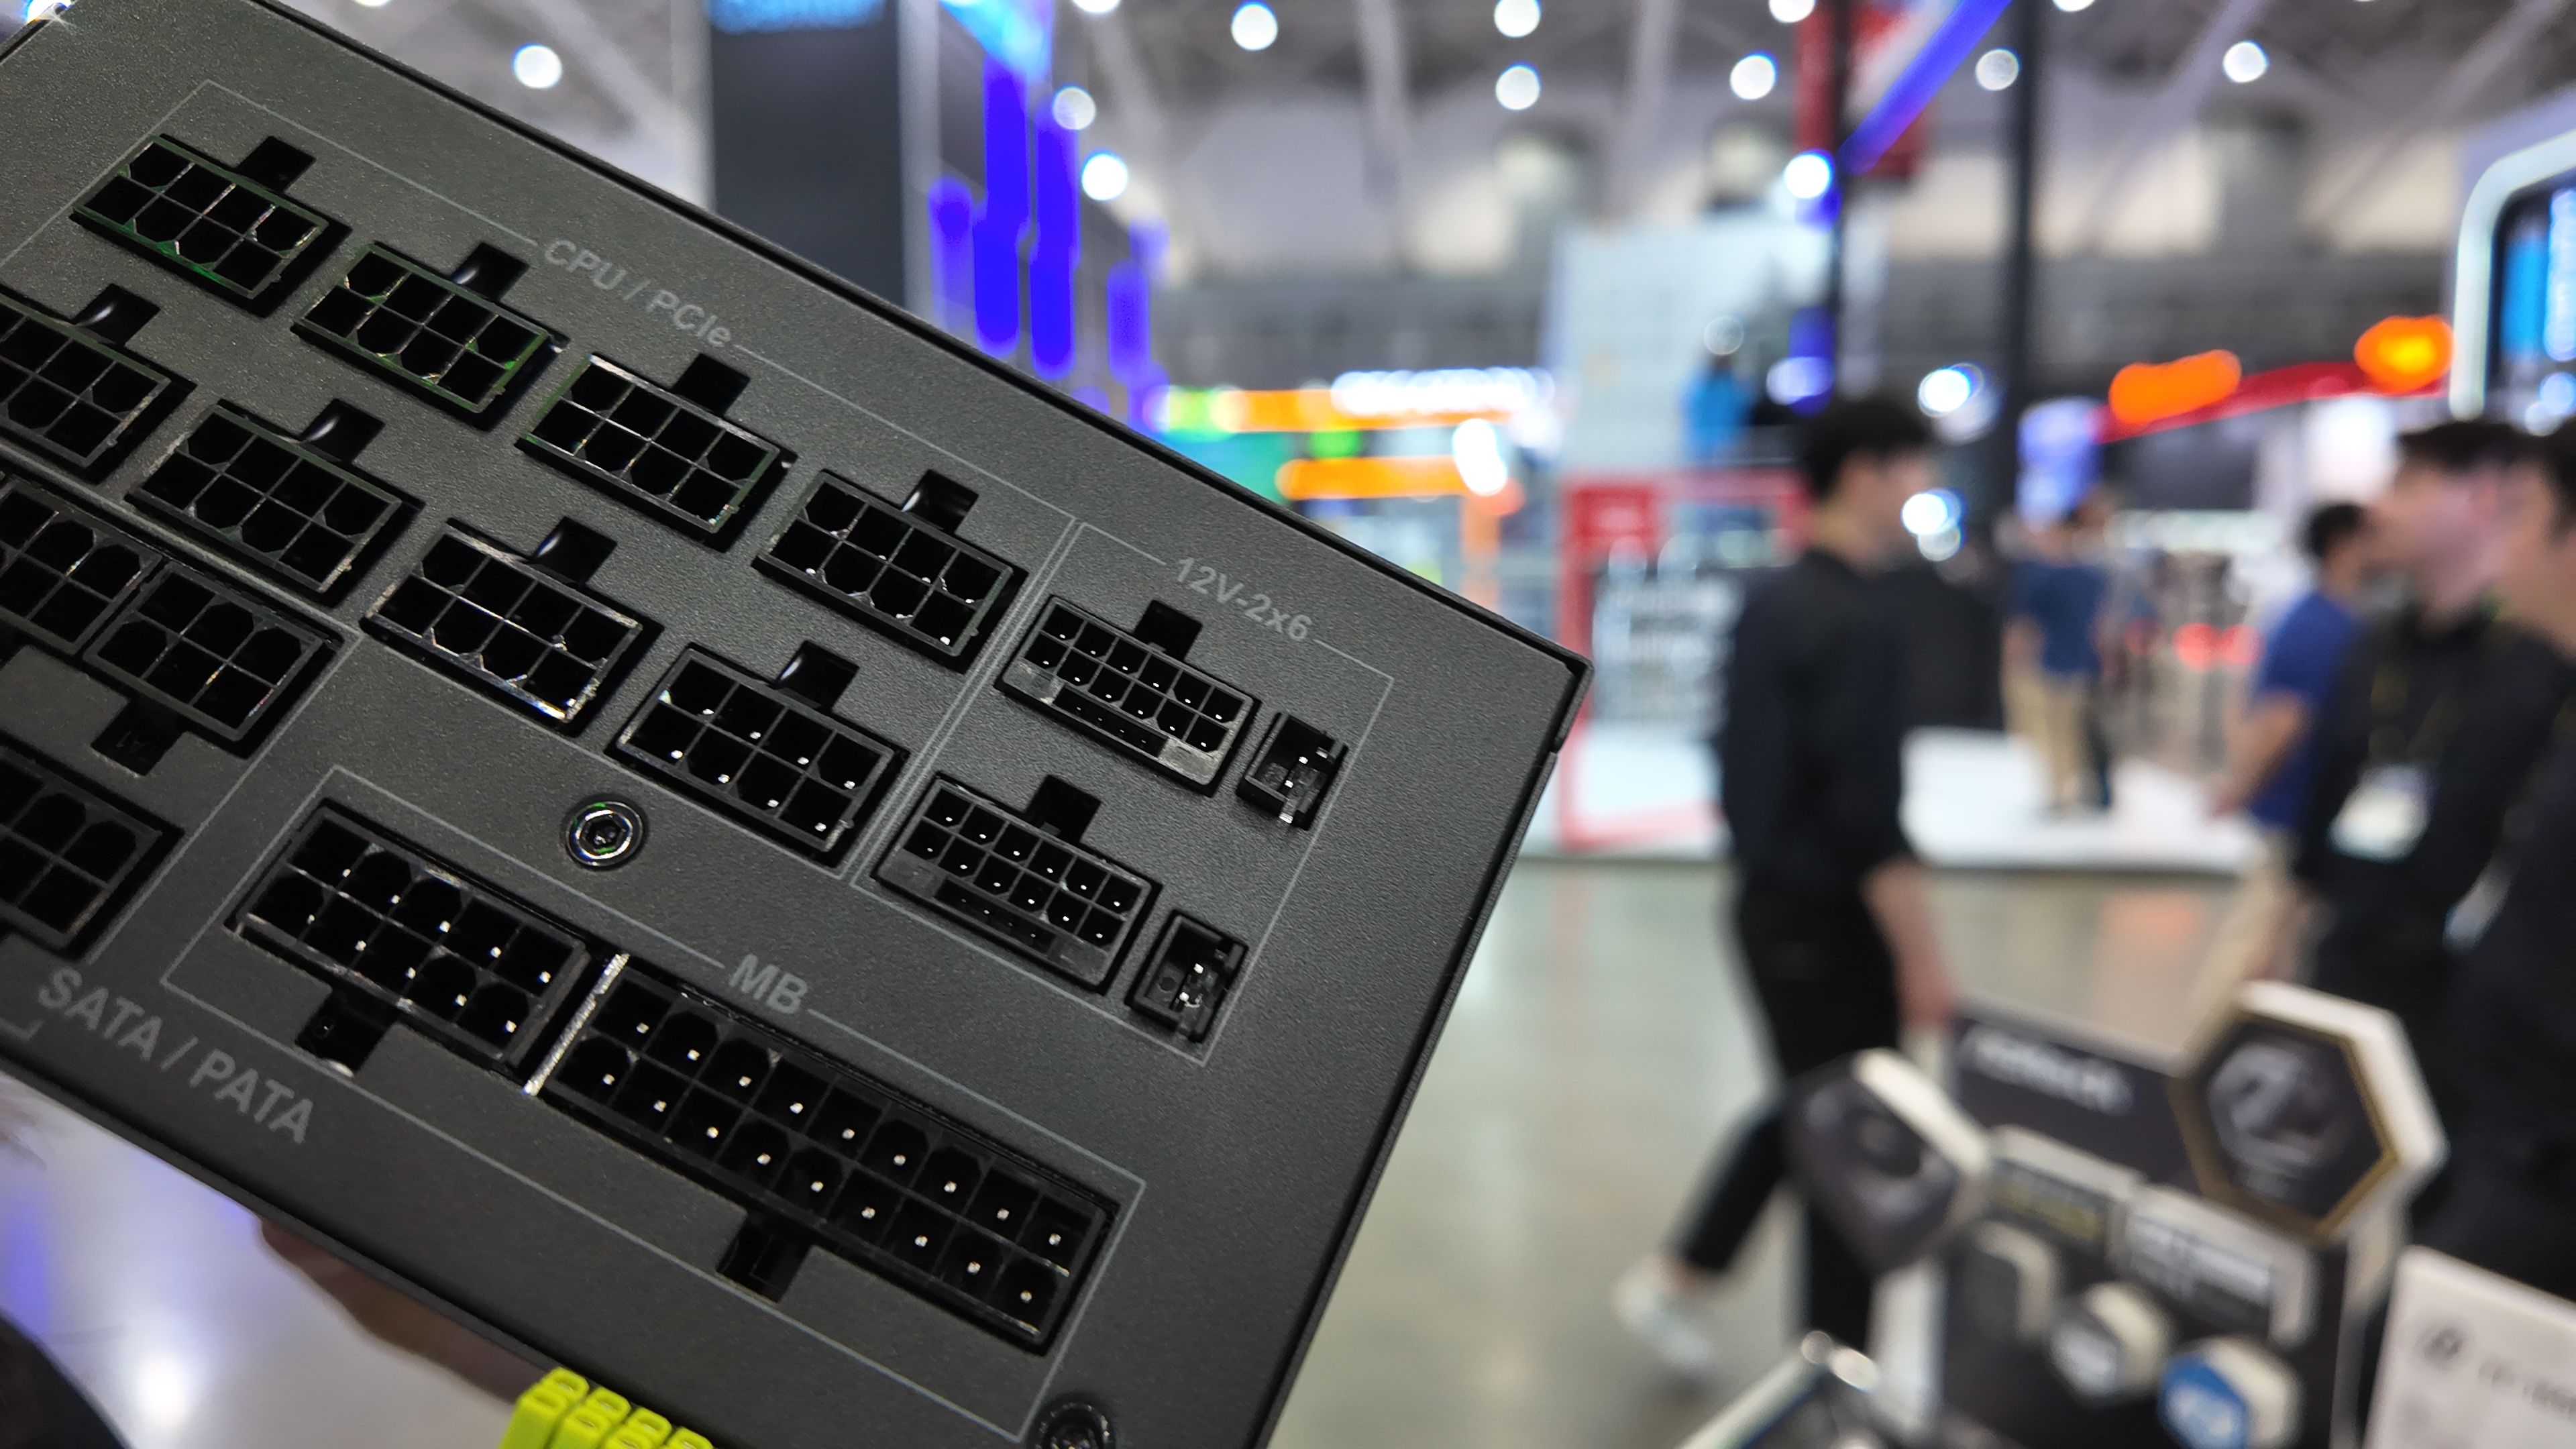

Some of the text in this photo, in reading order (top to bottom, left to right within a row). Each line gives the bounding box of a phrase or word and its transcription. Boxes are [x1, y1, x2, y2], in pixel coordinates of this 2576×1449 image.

[545, 239, 732, 347] CPU / PCIe
[1177, 557, 1313, 642] 12V-2x6
[729, 953, 808, 1014] MB
[38, 965, 314, 1144] SATA / PATA
